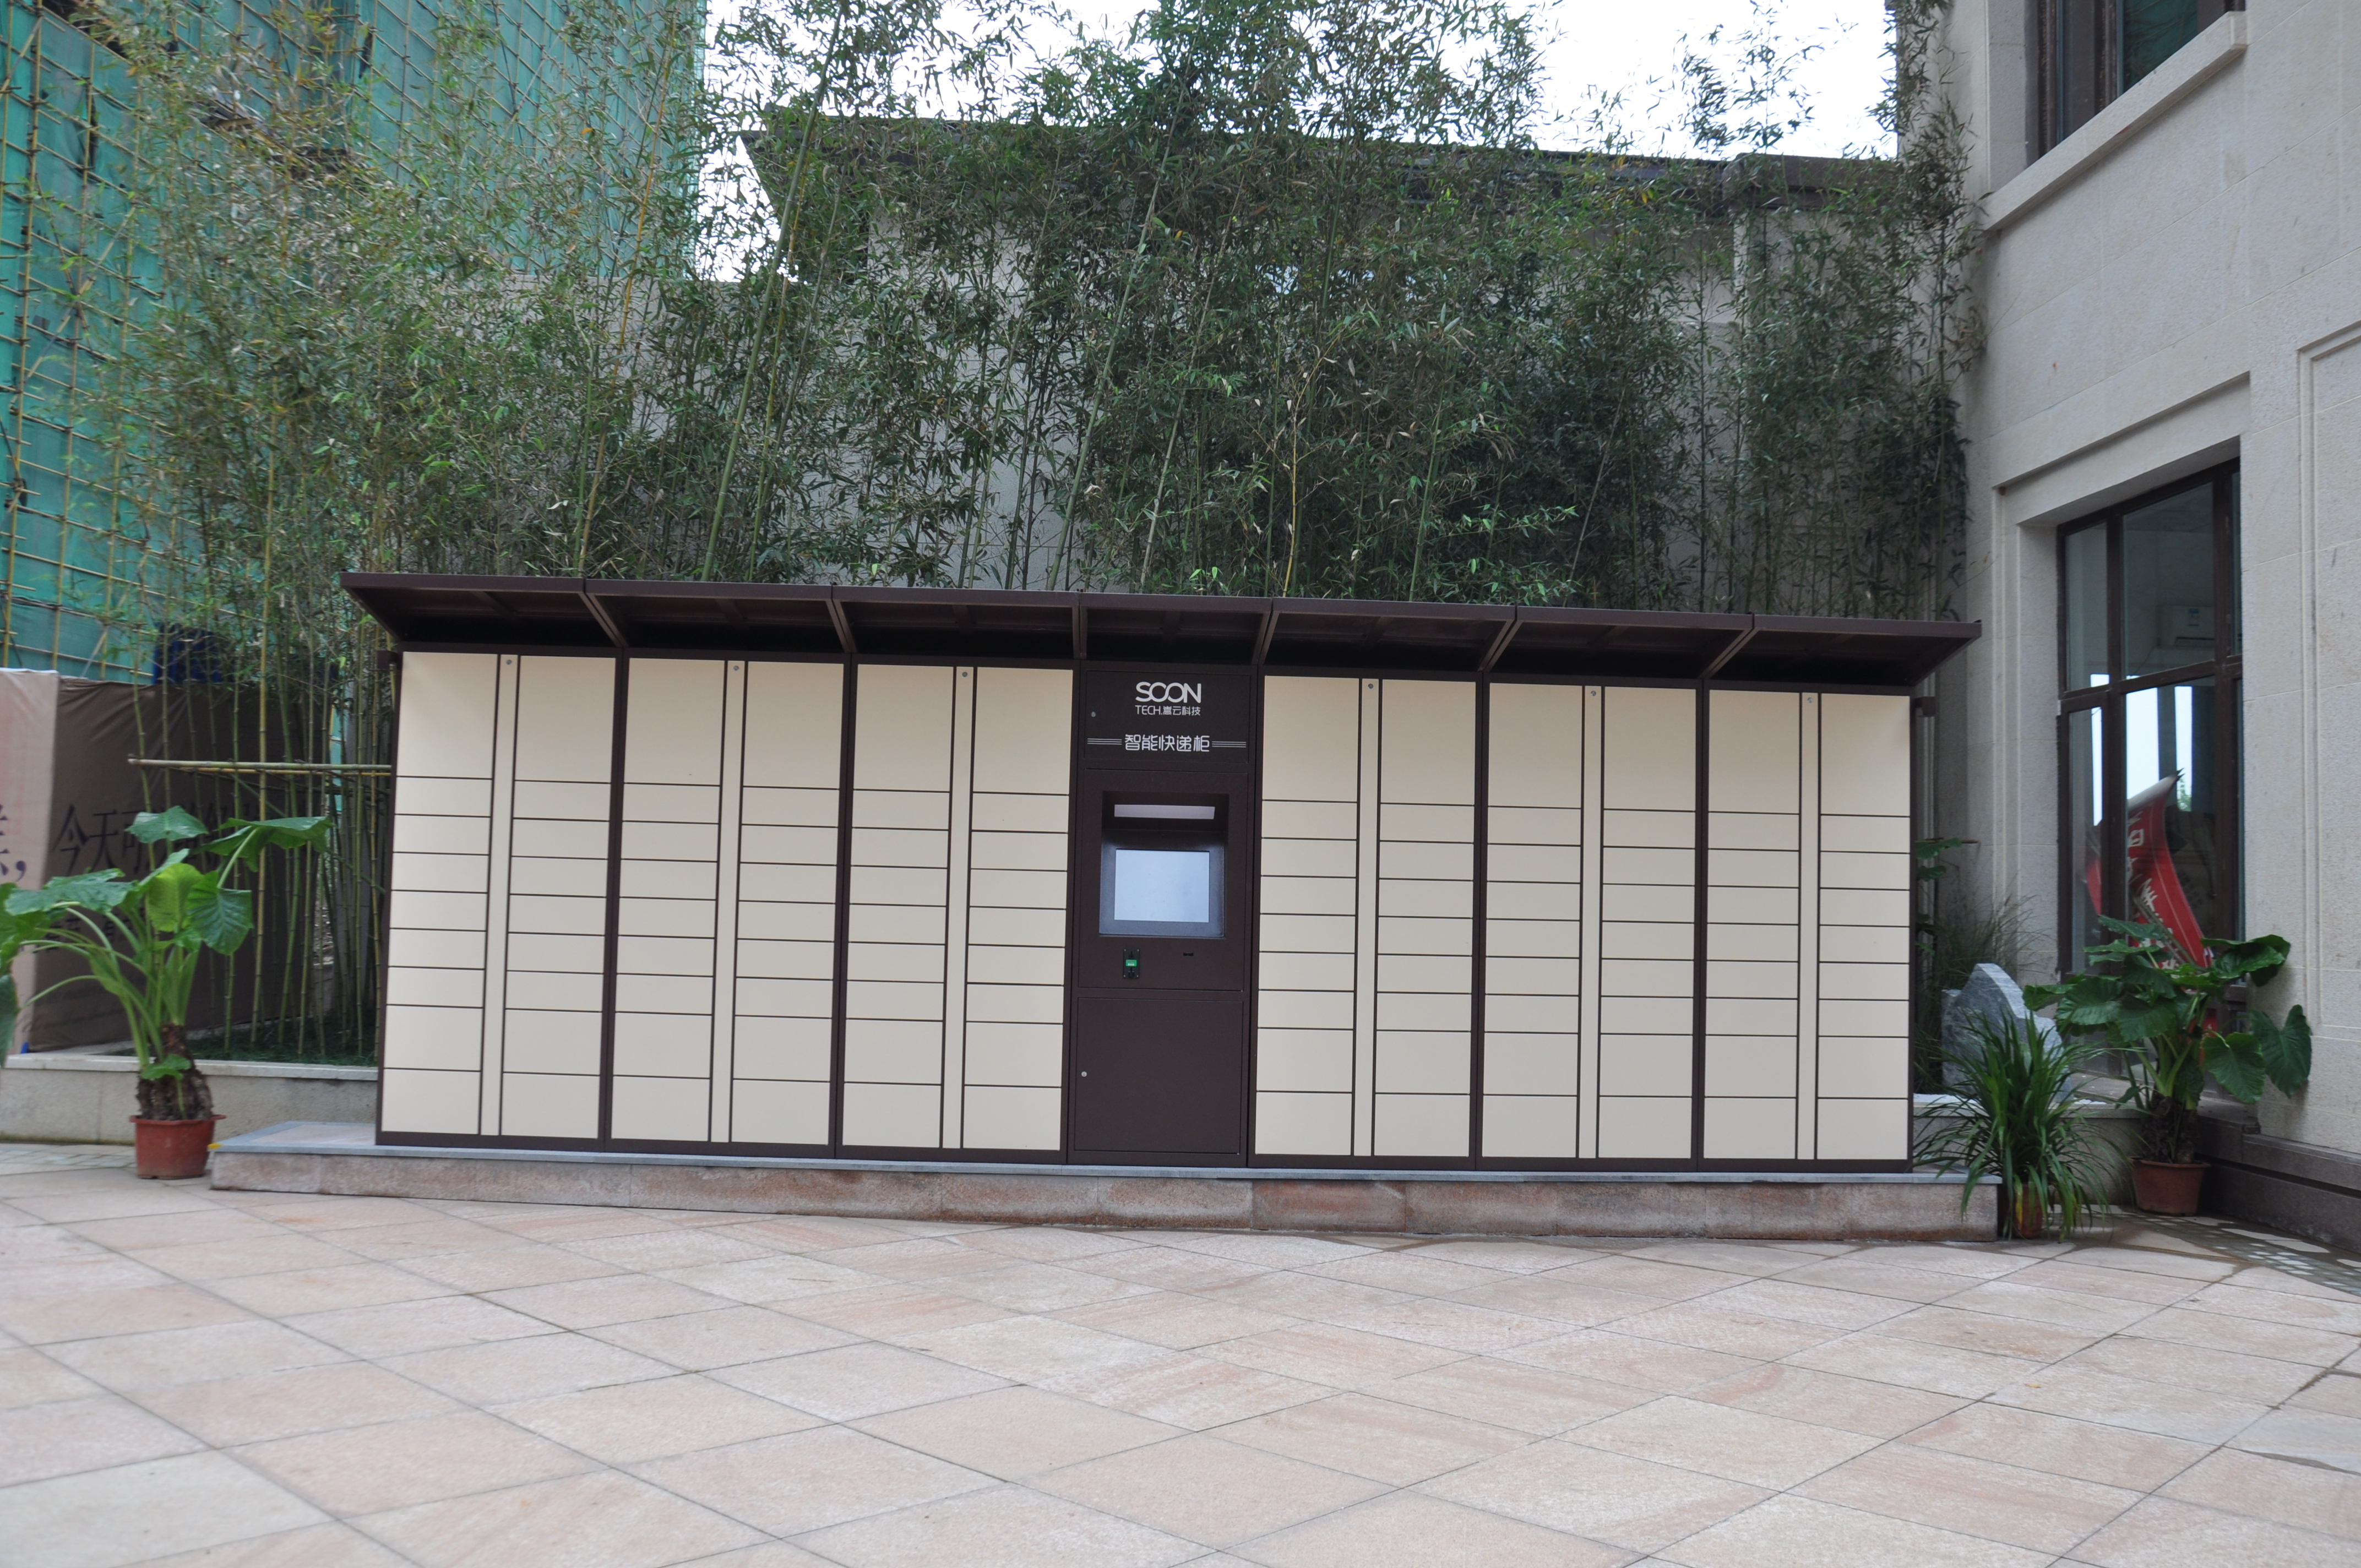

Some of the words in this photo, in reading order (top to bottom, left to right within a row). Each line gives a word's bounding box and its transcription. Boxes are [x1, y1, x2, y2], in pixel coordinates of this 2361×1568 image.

[1135, 682, 1201, 703] SOON
[1124, 734, 1210, 752] 智能快递柜
